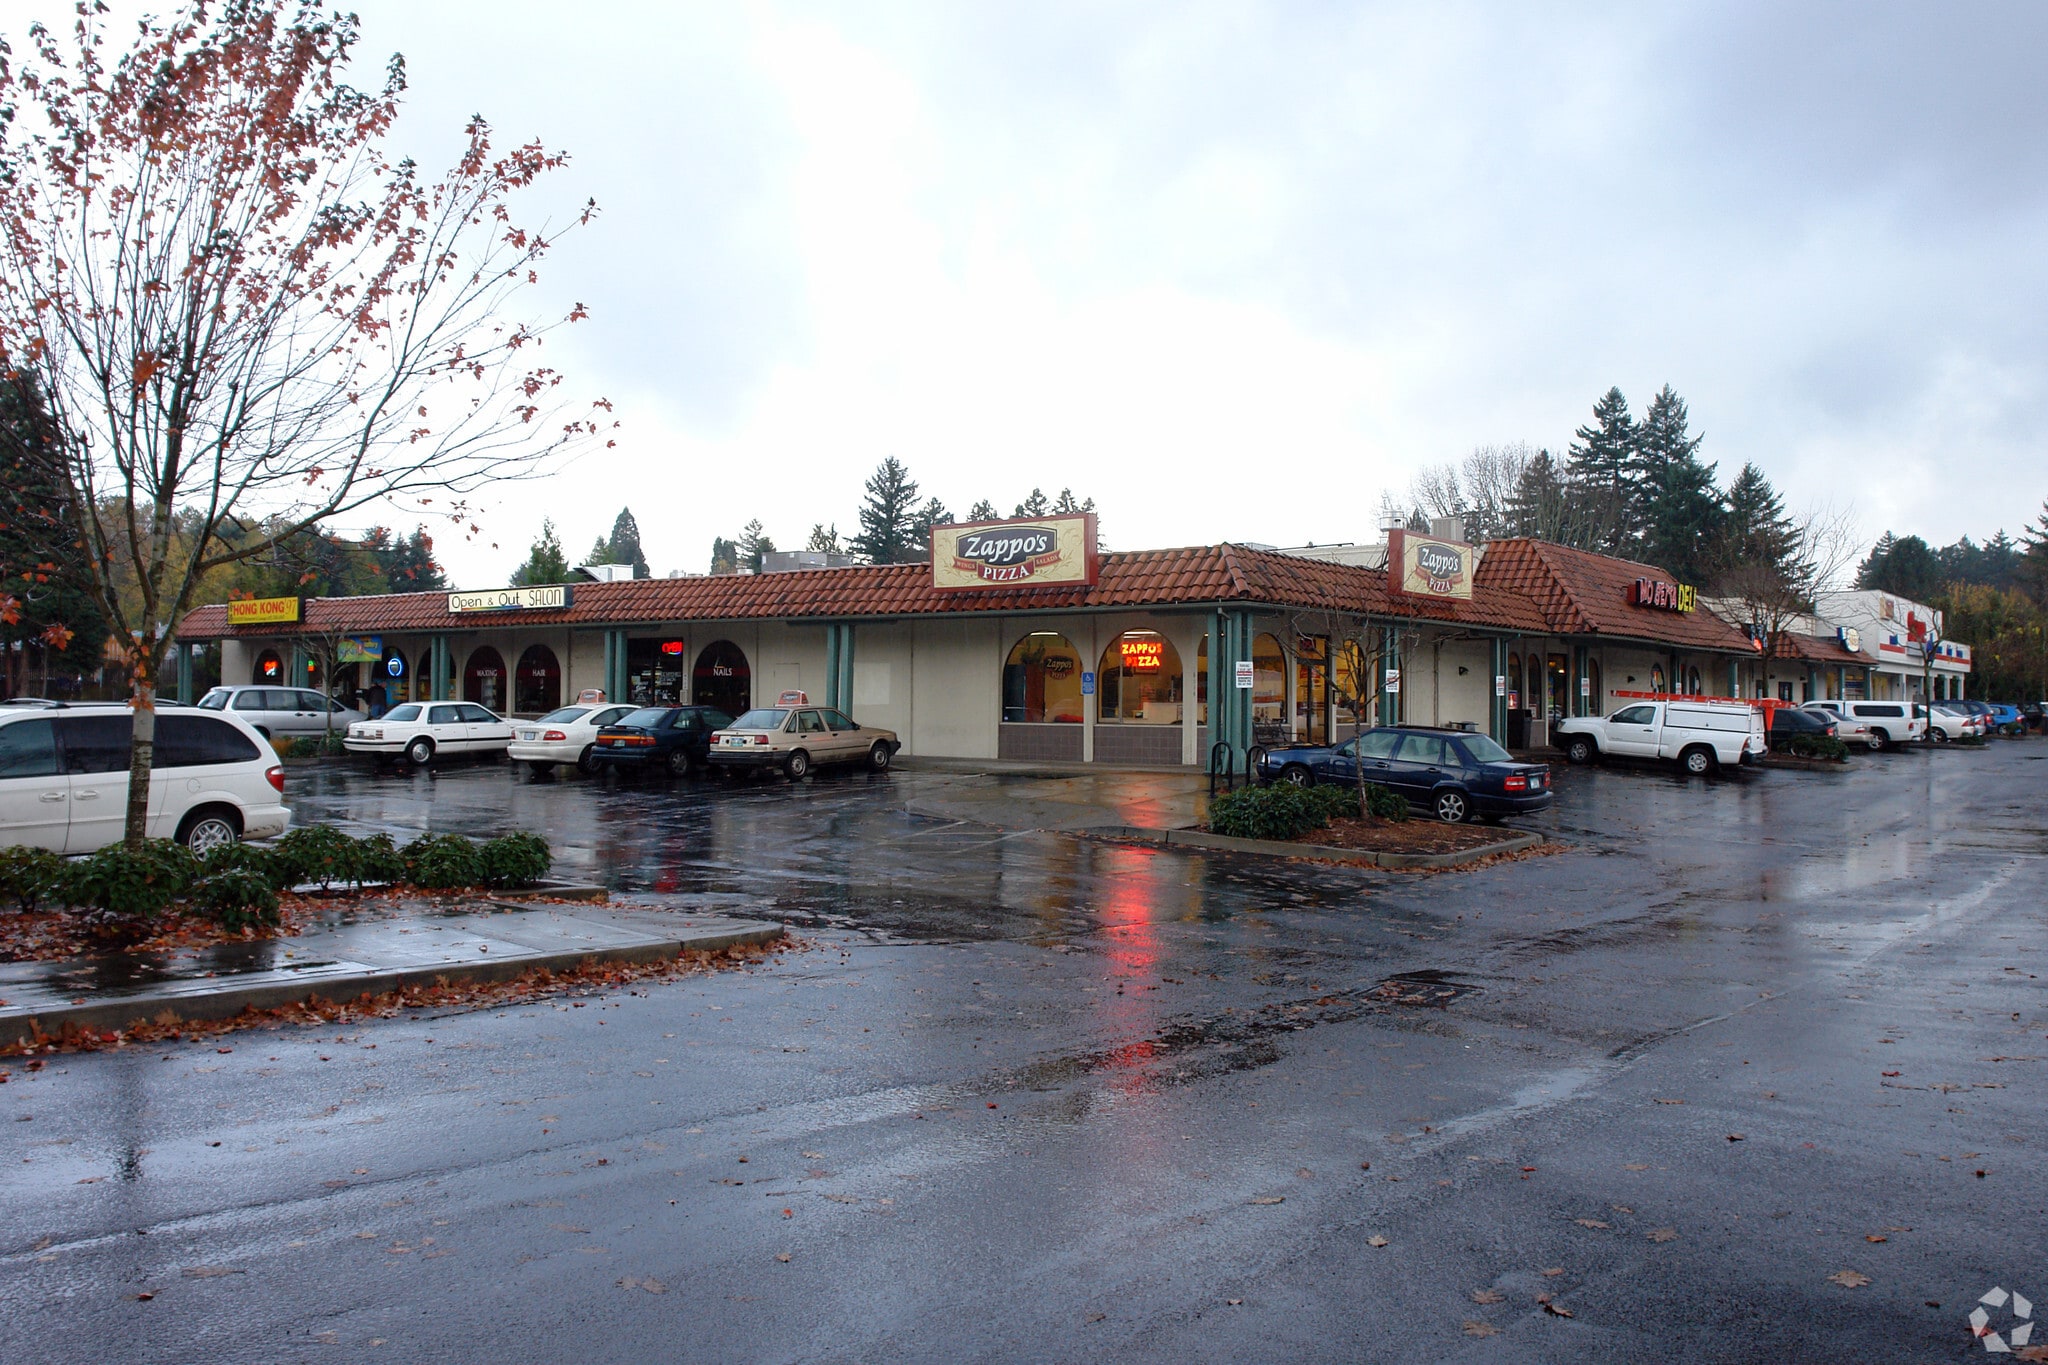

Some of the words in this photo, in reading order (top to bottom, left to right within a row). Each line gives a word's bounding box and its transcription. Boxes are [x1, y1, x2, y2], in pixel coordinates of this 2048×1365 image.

[965, 534, 1048, 562] Zappo's
[1421, 547, 1459, 575] Zappo's
[982, 564, 1030, 580] PIZZA
[1429, 577, 1451, 593] PIZZA
[451, 595, 482, 609] Open
[487, 597, 494, 606] &
[498, 592, 520, 606] Out
[528, 588, 561, 606] SALON
[1678, 583, 1697, 613] DELI
[233, 602, 257, 616] HONG
[260, 600, 285, 614] KONG
[1125, 656, 1160, 667] PIZZA
[476, 669, 498, 677] WAXING
[532, 668, 546, 677] HAIR
[713, 668, 732, 677] NAILS
